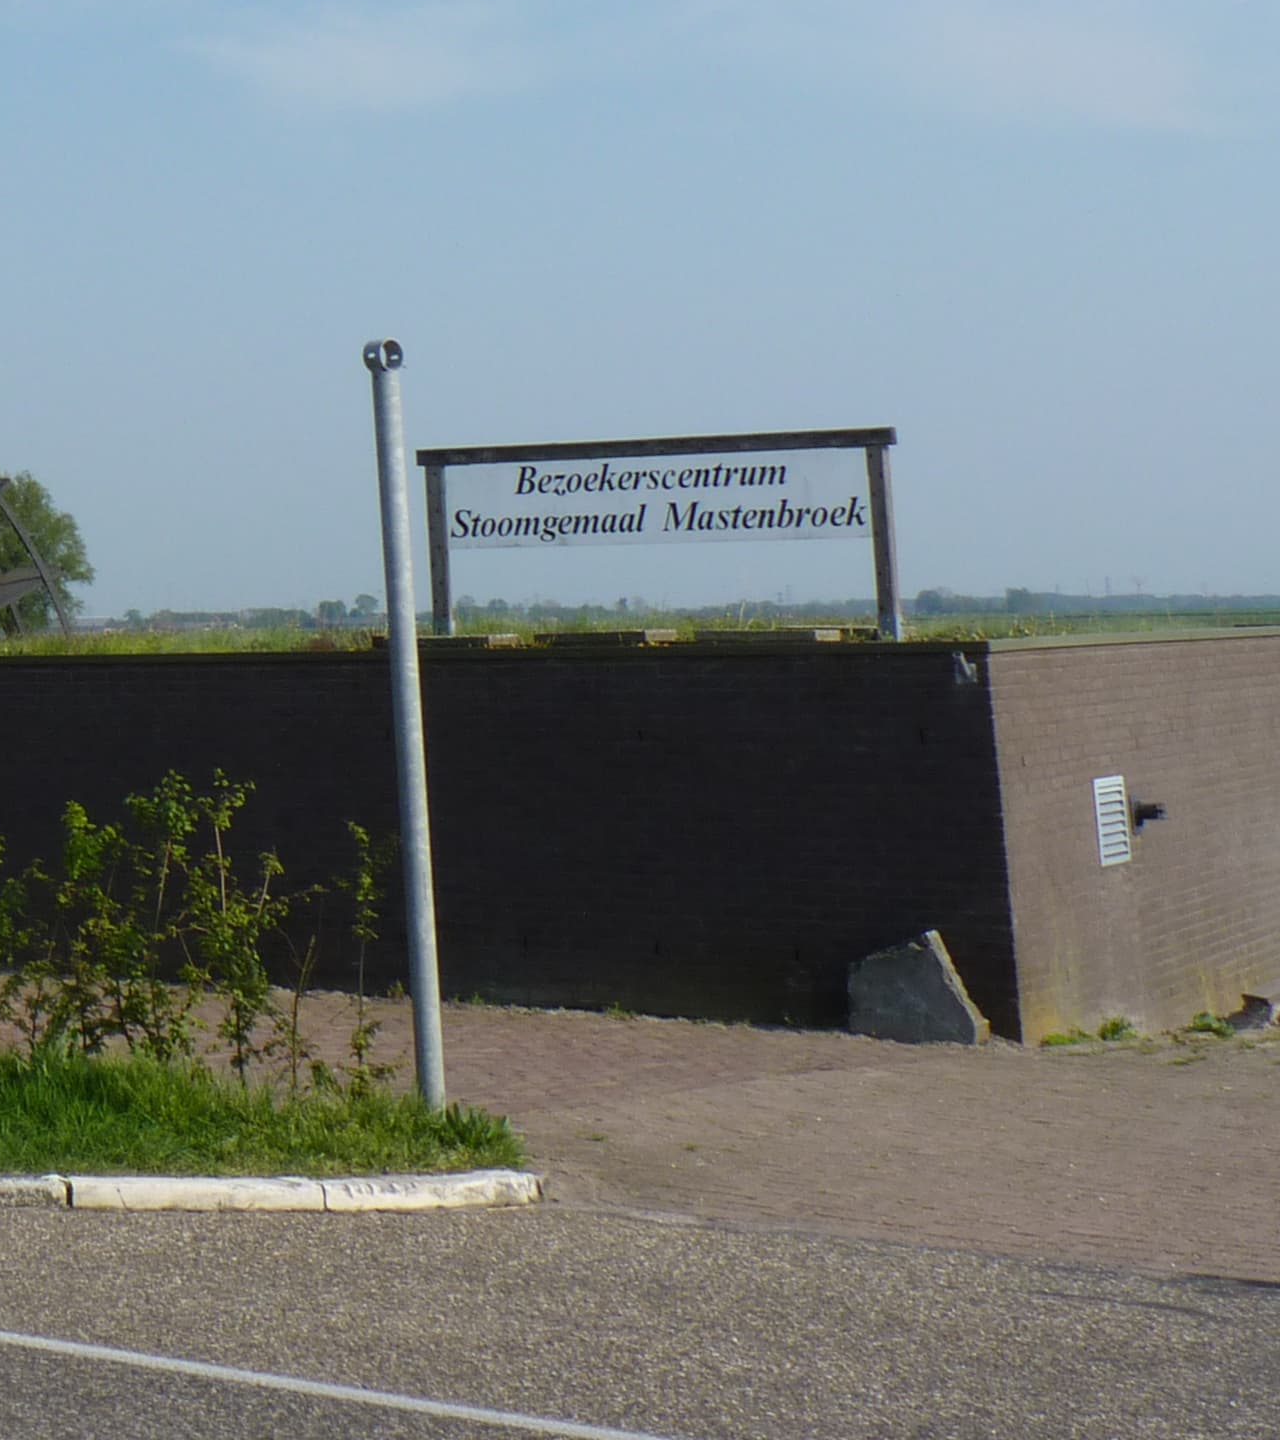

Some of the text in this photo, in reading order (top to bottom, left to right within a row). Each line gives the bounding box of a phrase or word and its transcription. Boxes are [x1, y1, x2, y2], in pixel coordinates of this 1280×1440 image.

[514, 462, 787, 496] Bezoekerscentrum
[450, 496, 866, 542] Stoomgemaal Mastenbroek
